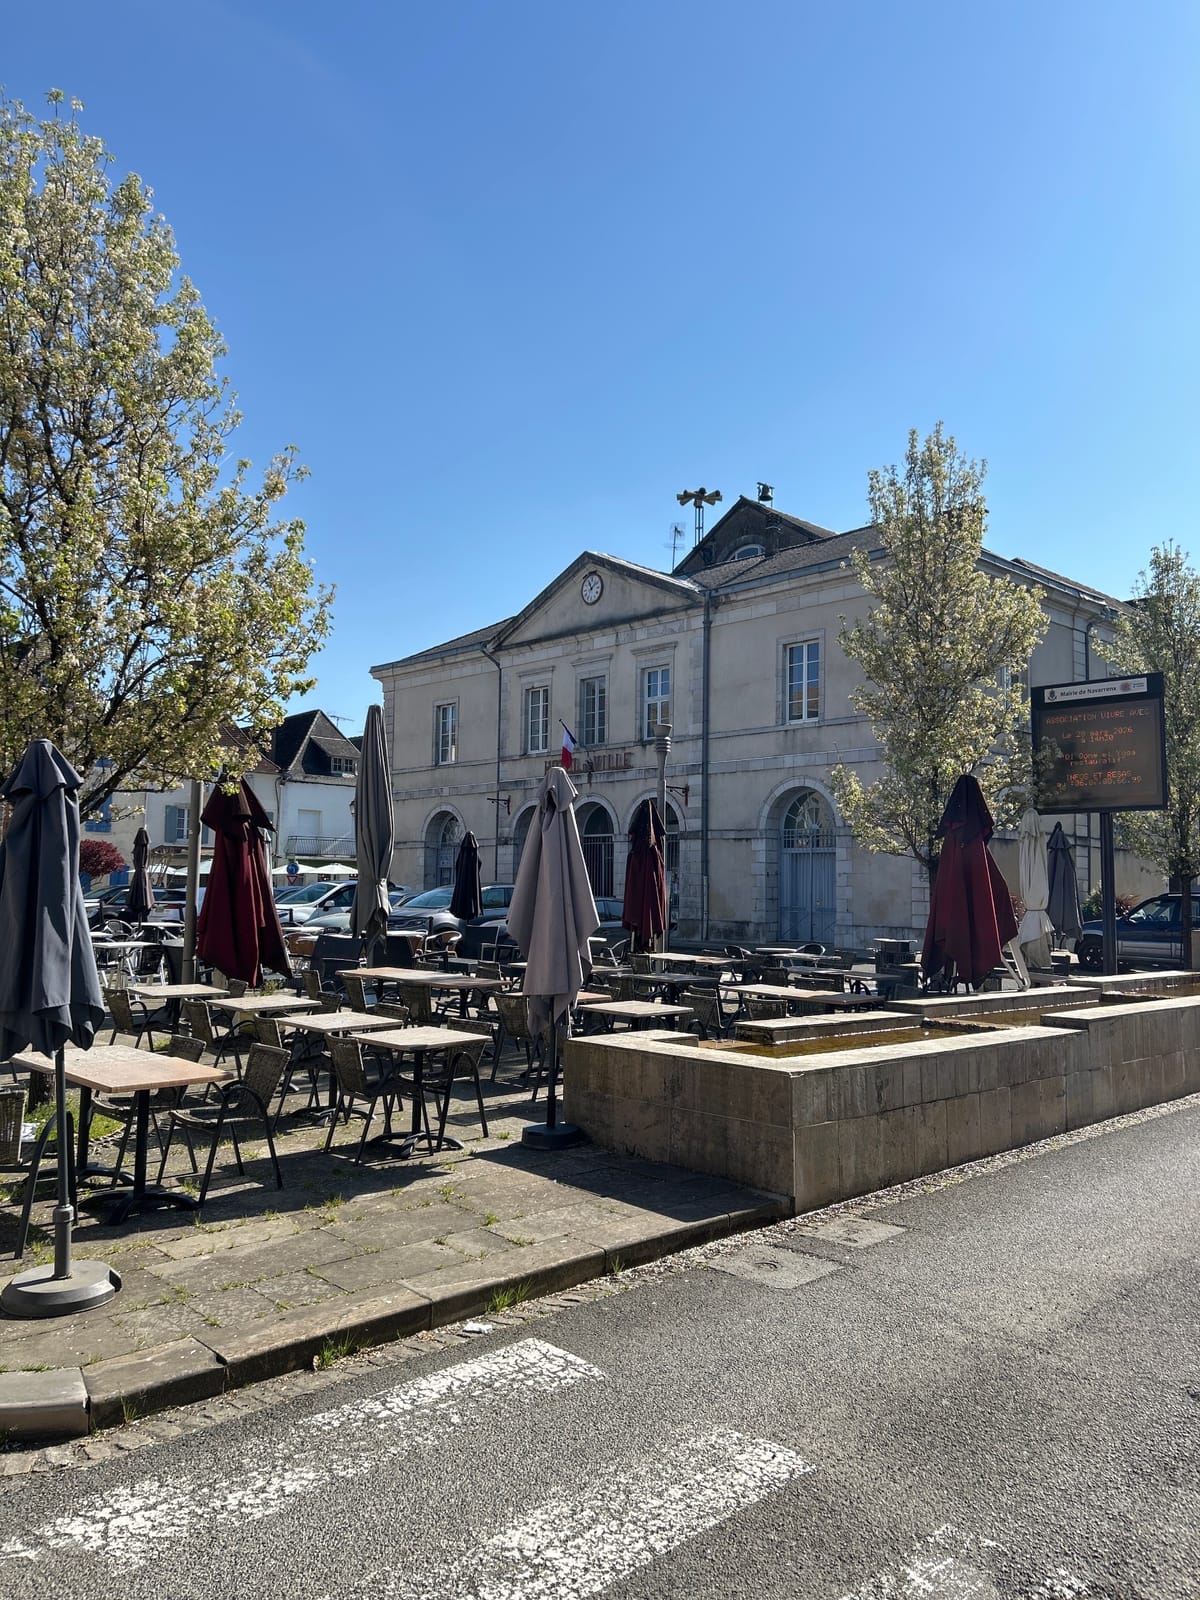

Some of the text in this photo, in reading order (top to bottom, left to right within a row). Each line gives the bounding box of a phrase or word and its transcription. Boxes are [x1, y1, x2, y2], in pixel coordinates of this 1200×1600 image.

[1046, 708, 1152, 724] ASSOCIATION VIVRE AVEC
[594, 752, 634, 771] VILLE
